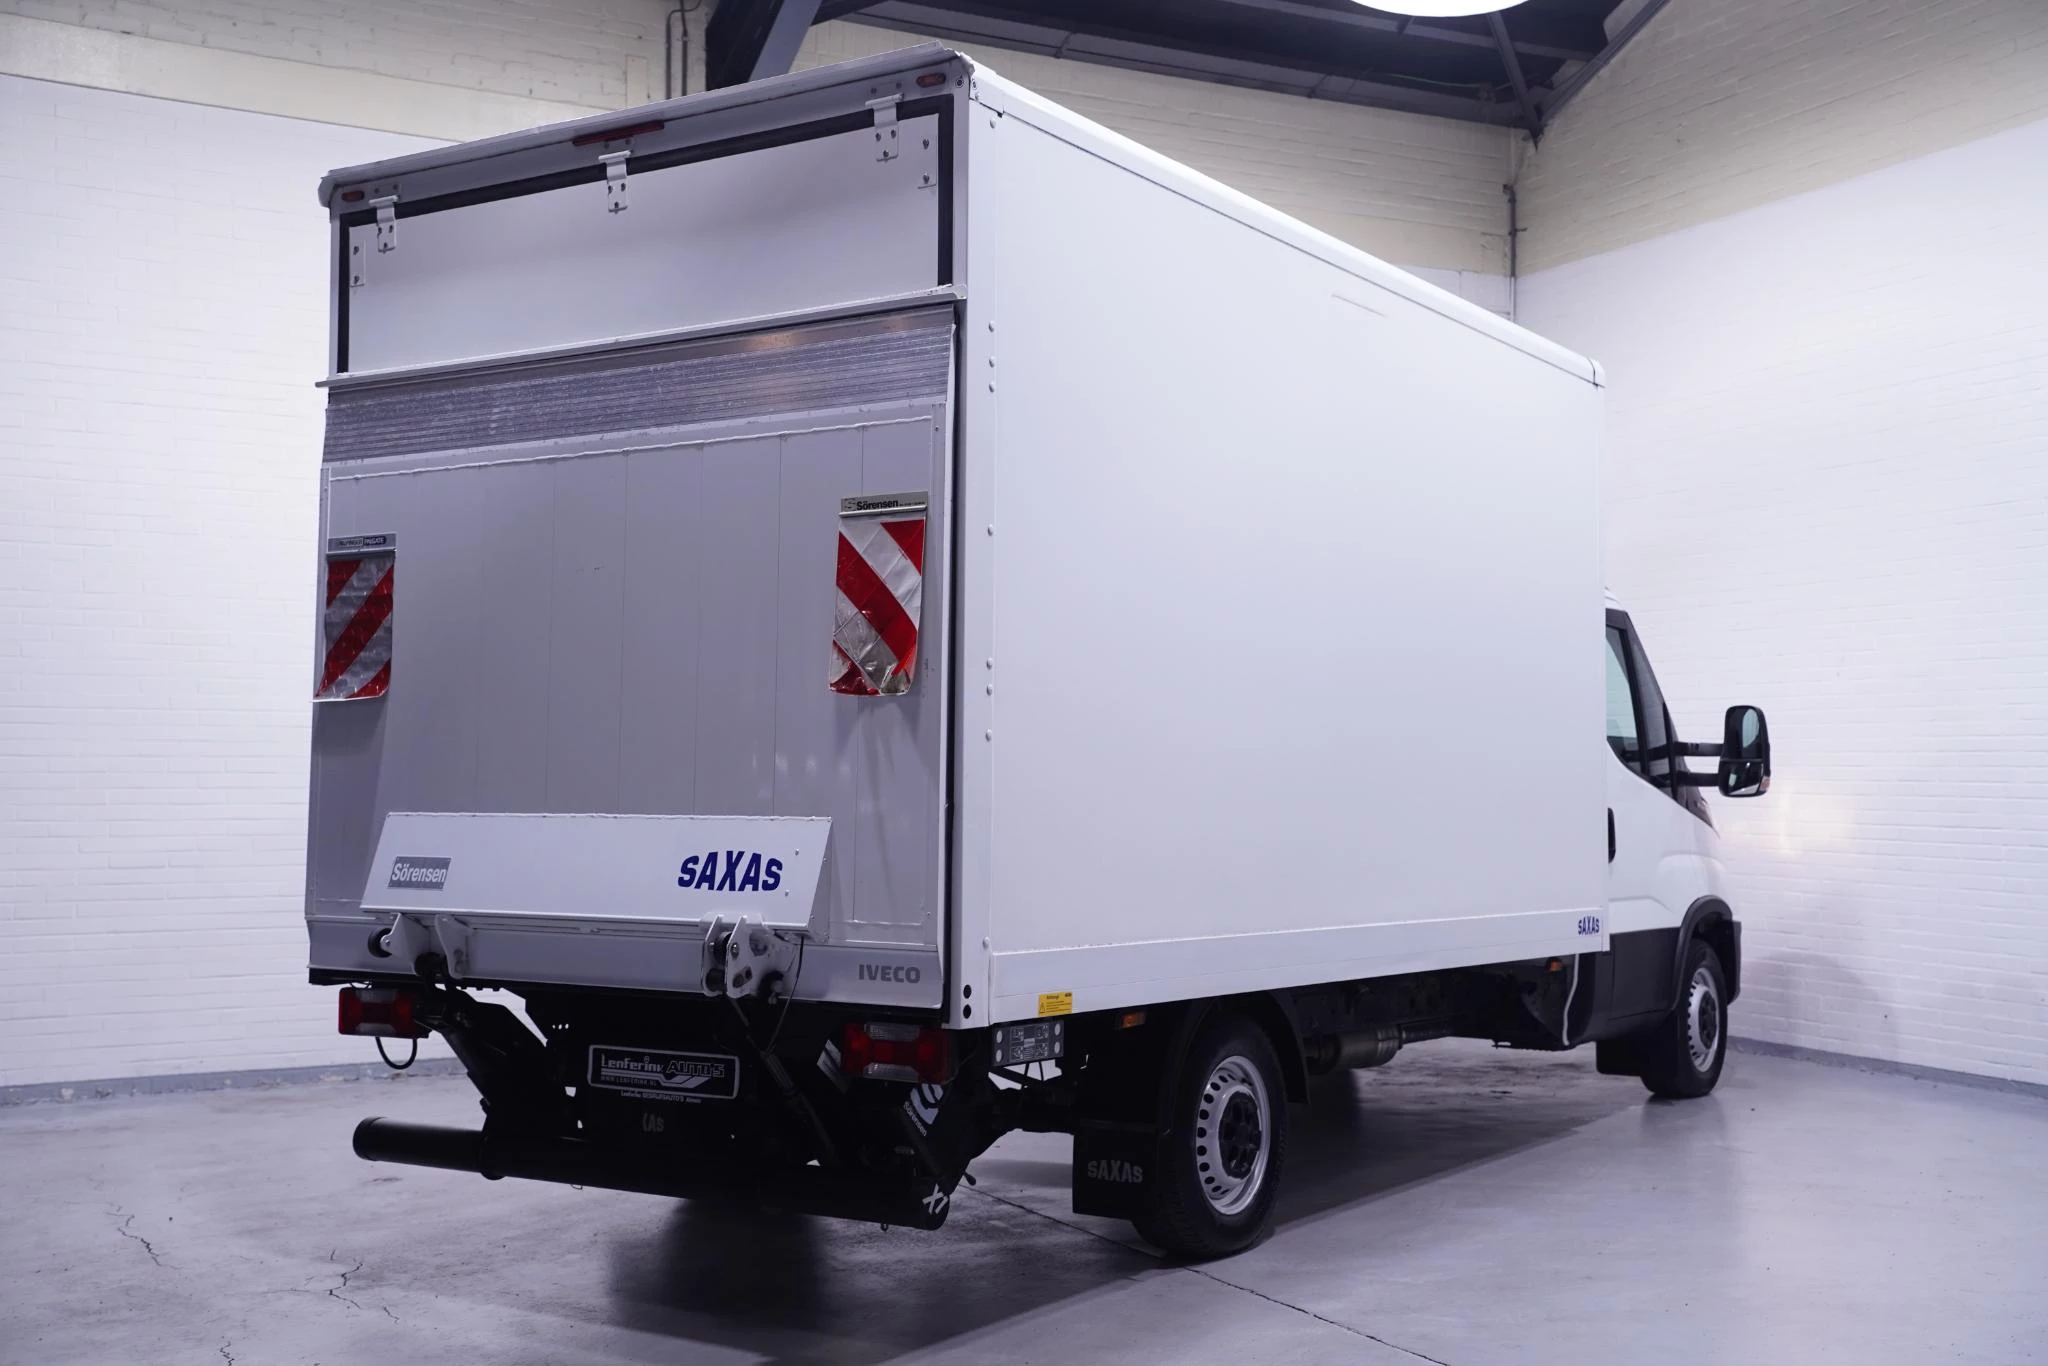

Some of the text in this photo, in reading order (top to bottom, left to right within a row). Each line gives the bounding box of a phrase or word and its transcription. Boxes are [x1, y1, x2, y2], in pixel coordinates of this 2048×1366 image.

[857, 500, 899, 511] Sörensen
[391, 863, 447, 882] Sörensen
[678, 850, 783, 891] SAXAS
[1578, 915, 1600, 935] SAXAS
[859, 964, 921, 983] IVECO
[601, 1053, 664, 1073] Lenferink
[1087, 1159, 1143, 1183] SAXAS
